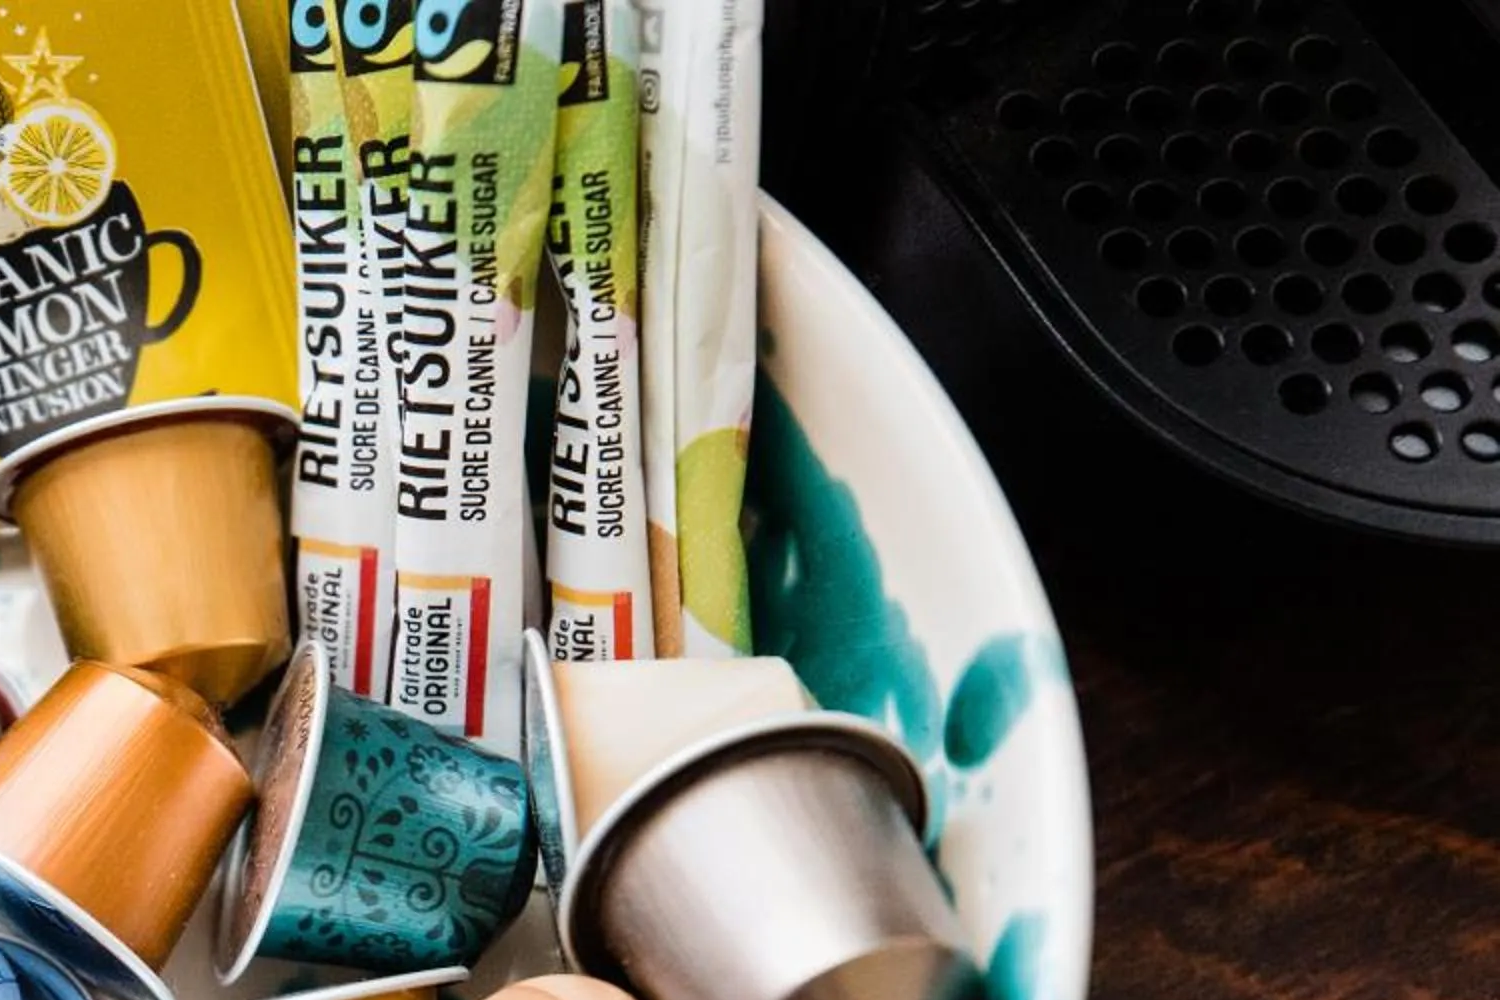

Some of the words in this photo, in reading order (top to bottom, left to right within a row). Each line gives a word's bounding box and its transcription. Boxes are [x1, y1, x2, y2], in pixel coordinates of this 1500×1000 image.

[471, 151, 499, 236] SUGAR
[581, 170, 614, 254] SUGAR
[469, 238, 498, 305] CANE
[586, 257, 616, 323] CANE
[293, 134, 349, 489] RIETSUIKER
[397, 150, 458, 521] RIETSUIKER
[355, 387, 381, 415] DE
[465, 334, 496, 412] CANNE
[593, 349, 622, 430] CANNE
[350, 421, 378, 491] SUCRE
[465, 417, 493, 445] DE
[598, 431, 625, 464] DE
[459, 450, 490, 522] SUCRE
[597, 465, 625, 538] SUCRE
[400, 606, 423, 705] fairtrade
[423, 596, 452, 716] ORIGINAL
